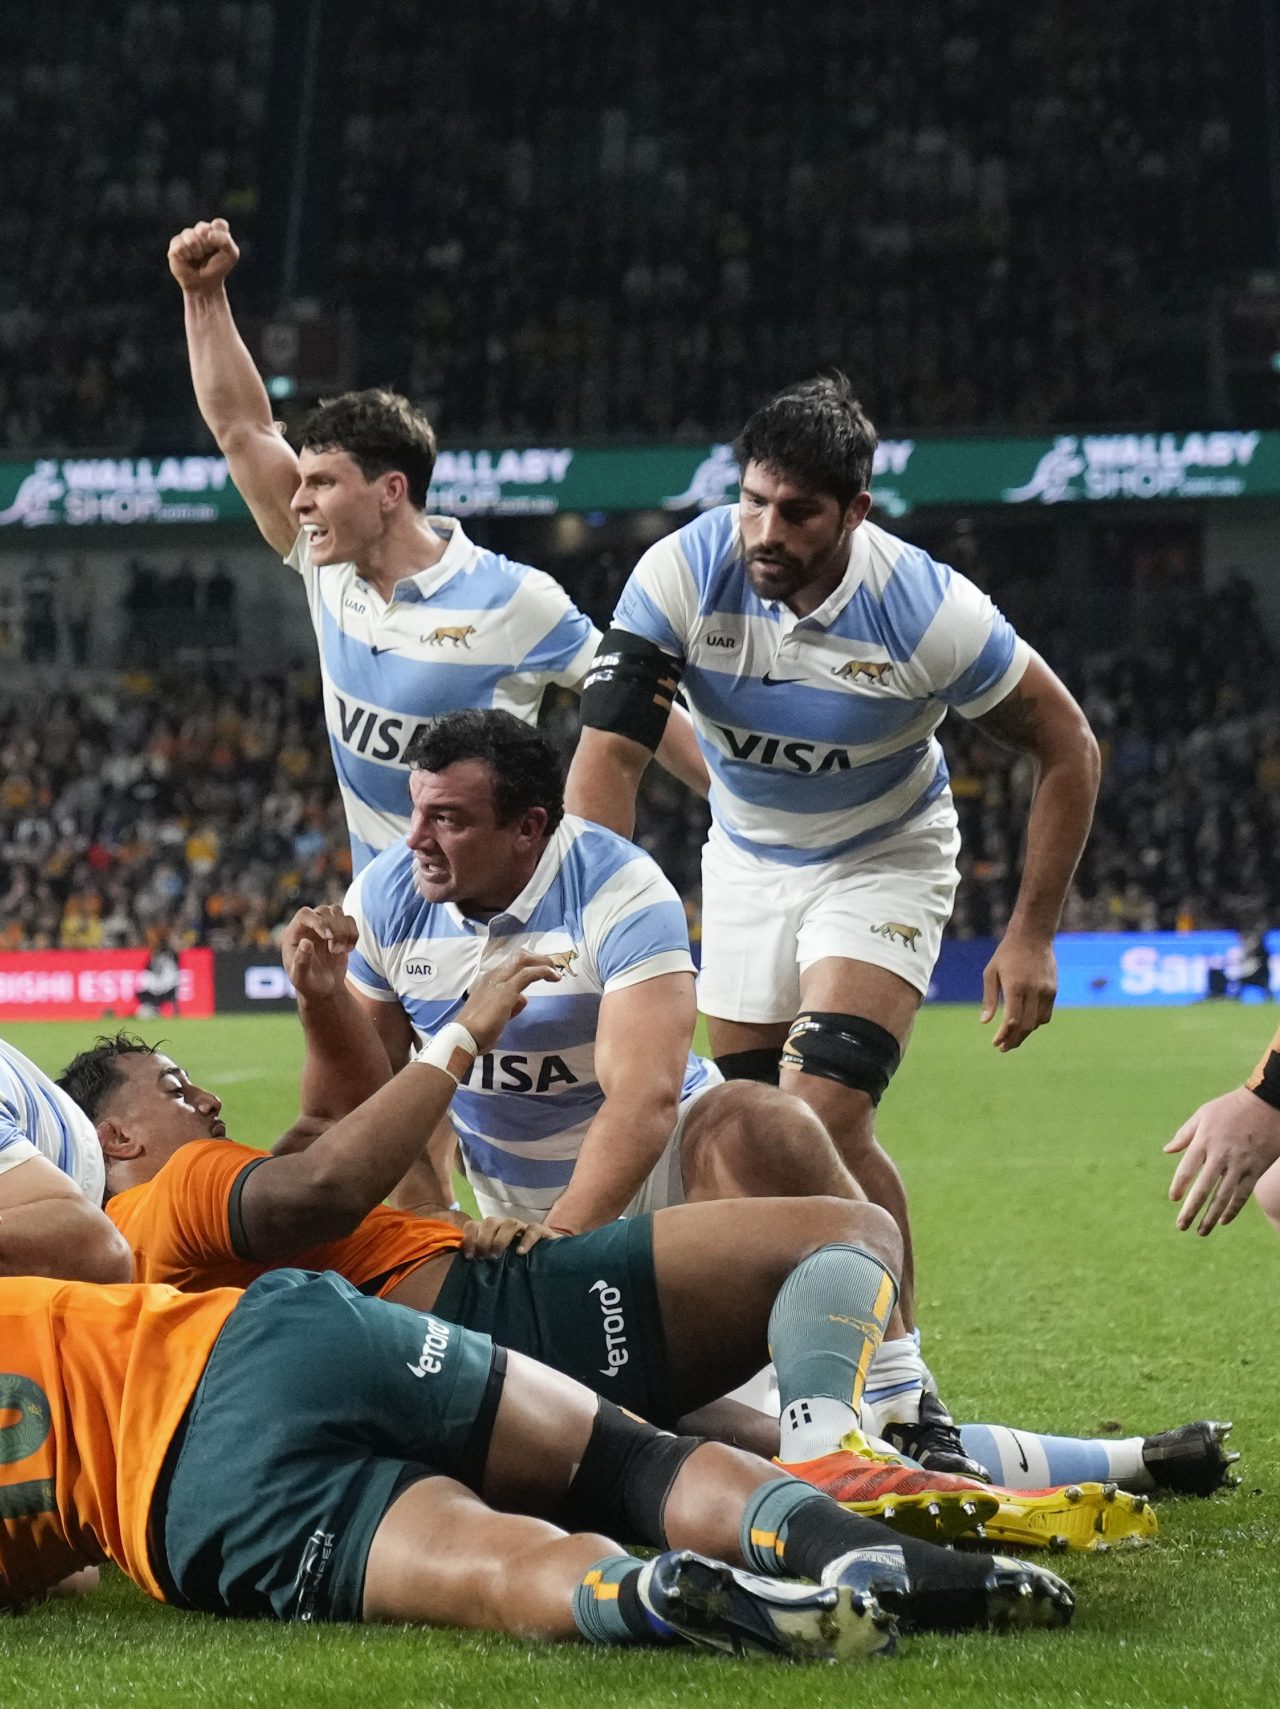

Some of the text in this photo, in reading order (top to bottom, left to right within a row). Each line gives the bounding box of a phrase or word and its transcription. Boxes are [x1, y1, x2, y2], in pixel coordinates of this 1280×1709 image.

[1083, 431, 1261, 467] WALLABY
[62, 456, 231, 492] WALLABY
[345, 599, 366, 616] UAR
[706, 635, 736, 649] UAR
[713, 723, 852, 776] VISA
[406, 963, 432, 976] UAR
[593, 1280, 629, 1376] eToro
